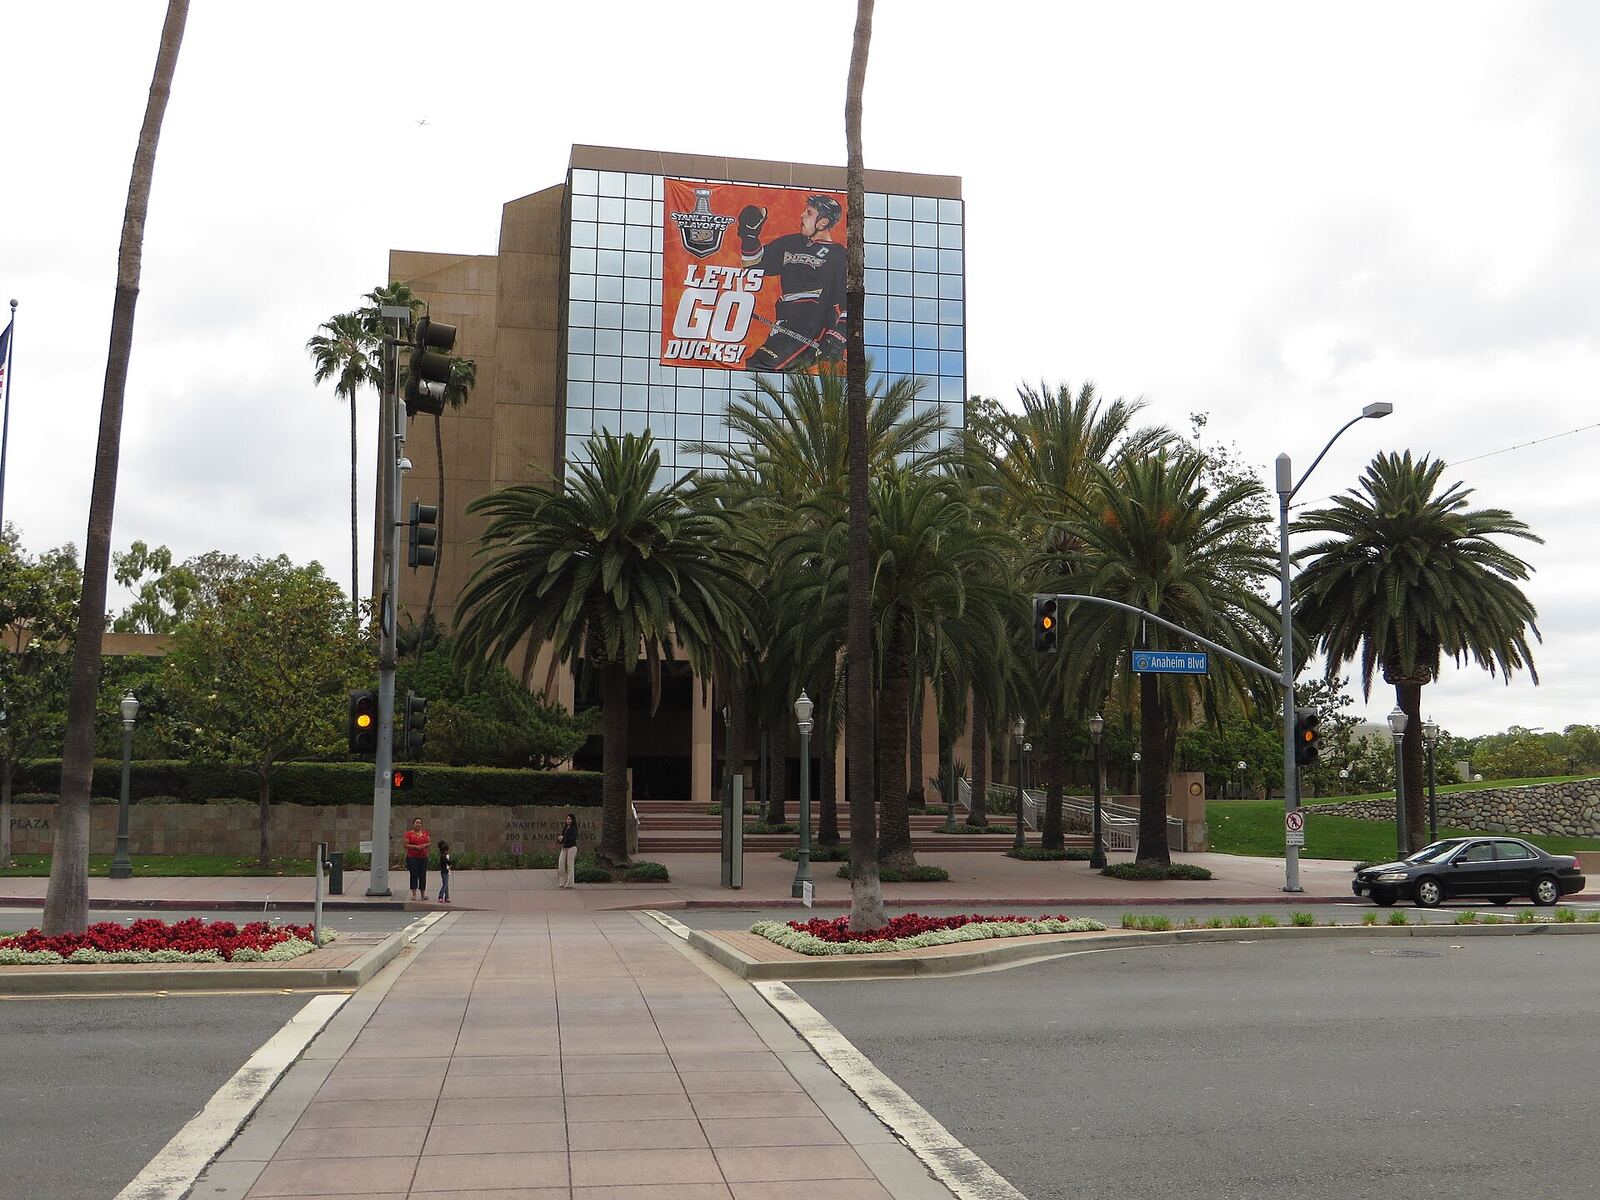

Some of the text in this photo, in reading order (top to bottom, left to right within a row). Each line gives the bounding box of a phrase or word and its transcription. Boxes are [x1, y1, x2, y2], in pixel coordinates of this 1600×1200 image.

[670, 212, 735, 224] STANLEY CUP
[678, 221, 726, 231] PLAYOFFS
[683, 264, 764, 292] LET'S
[672, 288, 755, 343] GO
[664, 340, 746, 363] DUCKS!
[1151, 656, 1185, 668] Anaheim
[1187, 657, 1205, 669] Blvd
[10, 819, 49, 829] PLAZA
[505, 821, 546, 829] ANAHEIM
